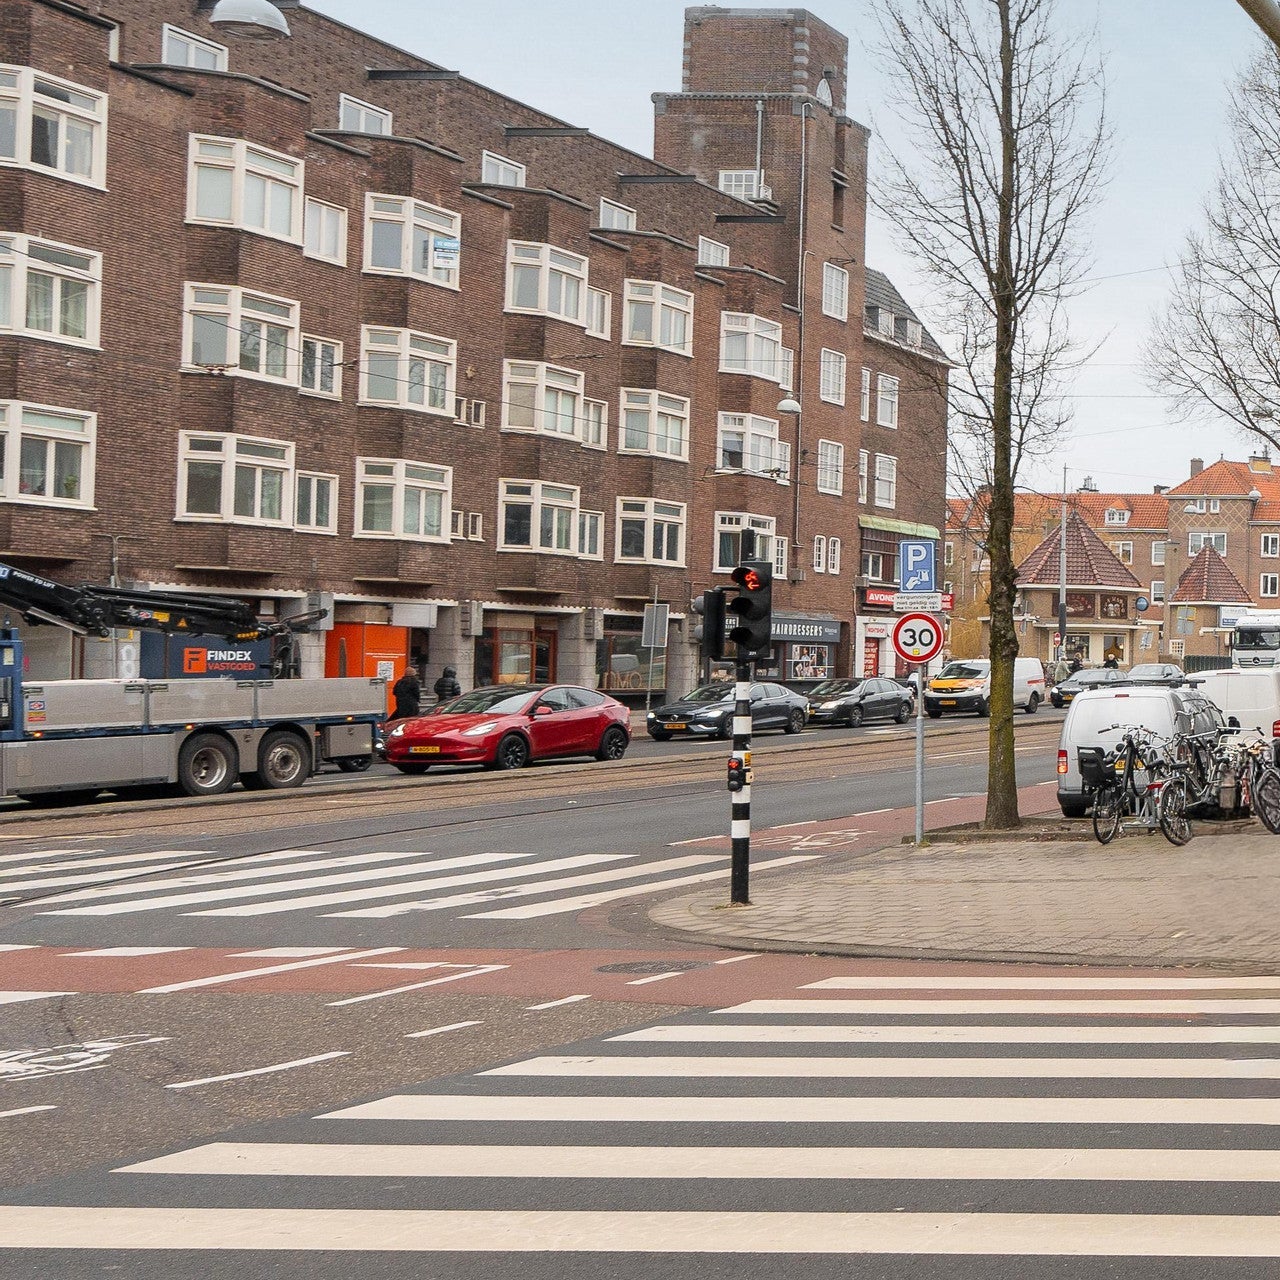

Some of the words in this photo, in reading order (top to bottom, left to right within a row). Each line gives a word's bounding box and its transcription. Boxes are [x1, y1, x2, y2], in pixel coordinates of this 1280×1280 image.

[907, 545, 926, 571] P
[771, 623, 823, 636] HAIRDRESSERS
[902, 628, 934, 647] 30
[207, 651, 251, 660] FINDEX
